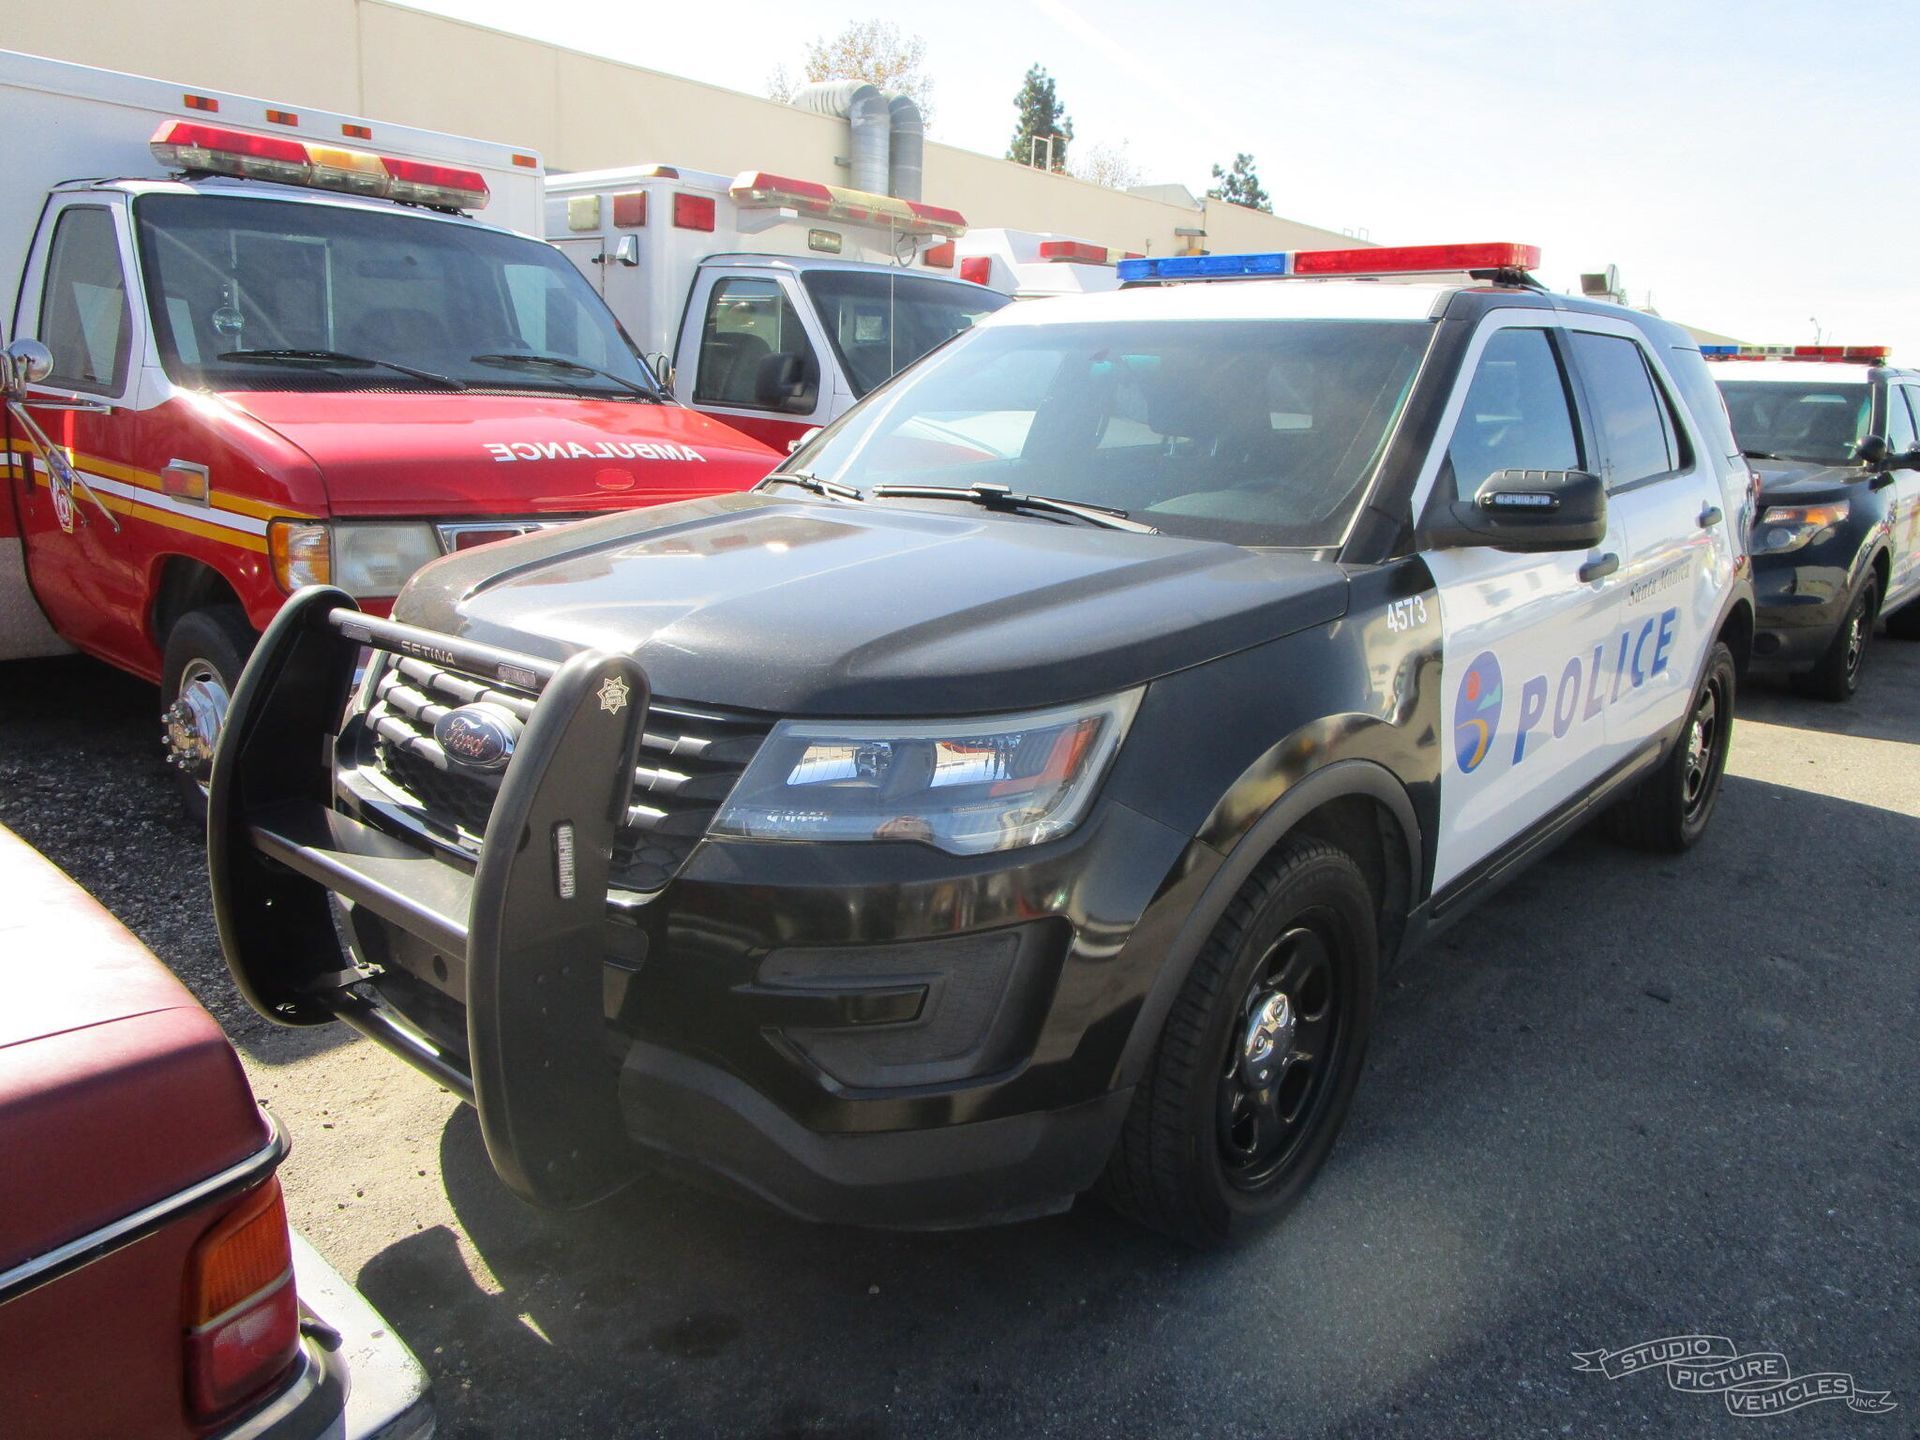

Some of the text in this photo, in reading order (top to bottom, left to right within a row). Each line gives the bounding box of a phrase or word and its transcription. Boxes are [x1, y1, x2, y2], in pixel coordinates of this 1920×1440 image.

[1386, 594, 1428, 633] 4573
[401, 640, 456, 665] SETINA
[1511, 606, 1677, 767] POLICE
[444, 716, 490, 757] Ford
